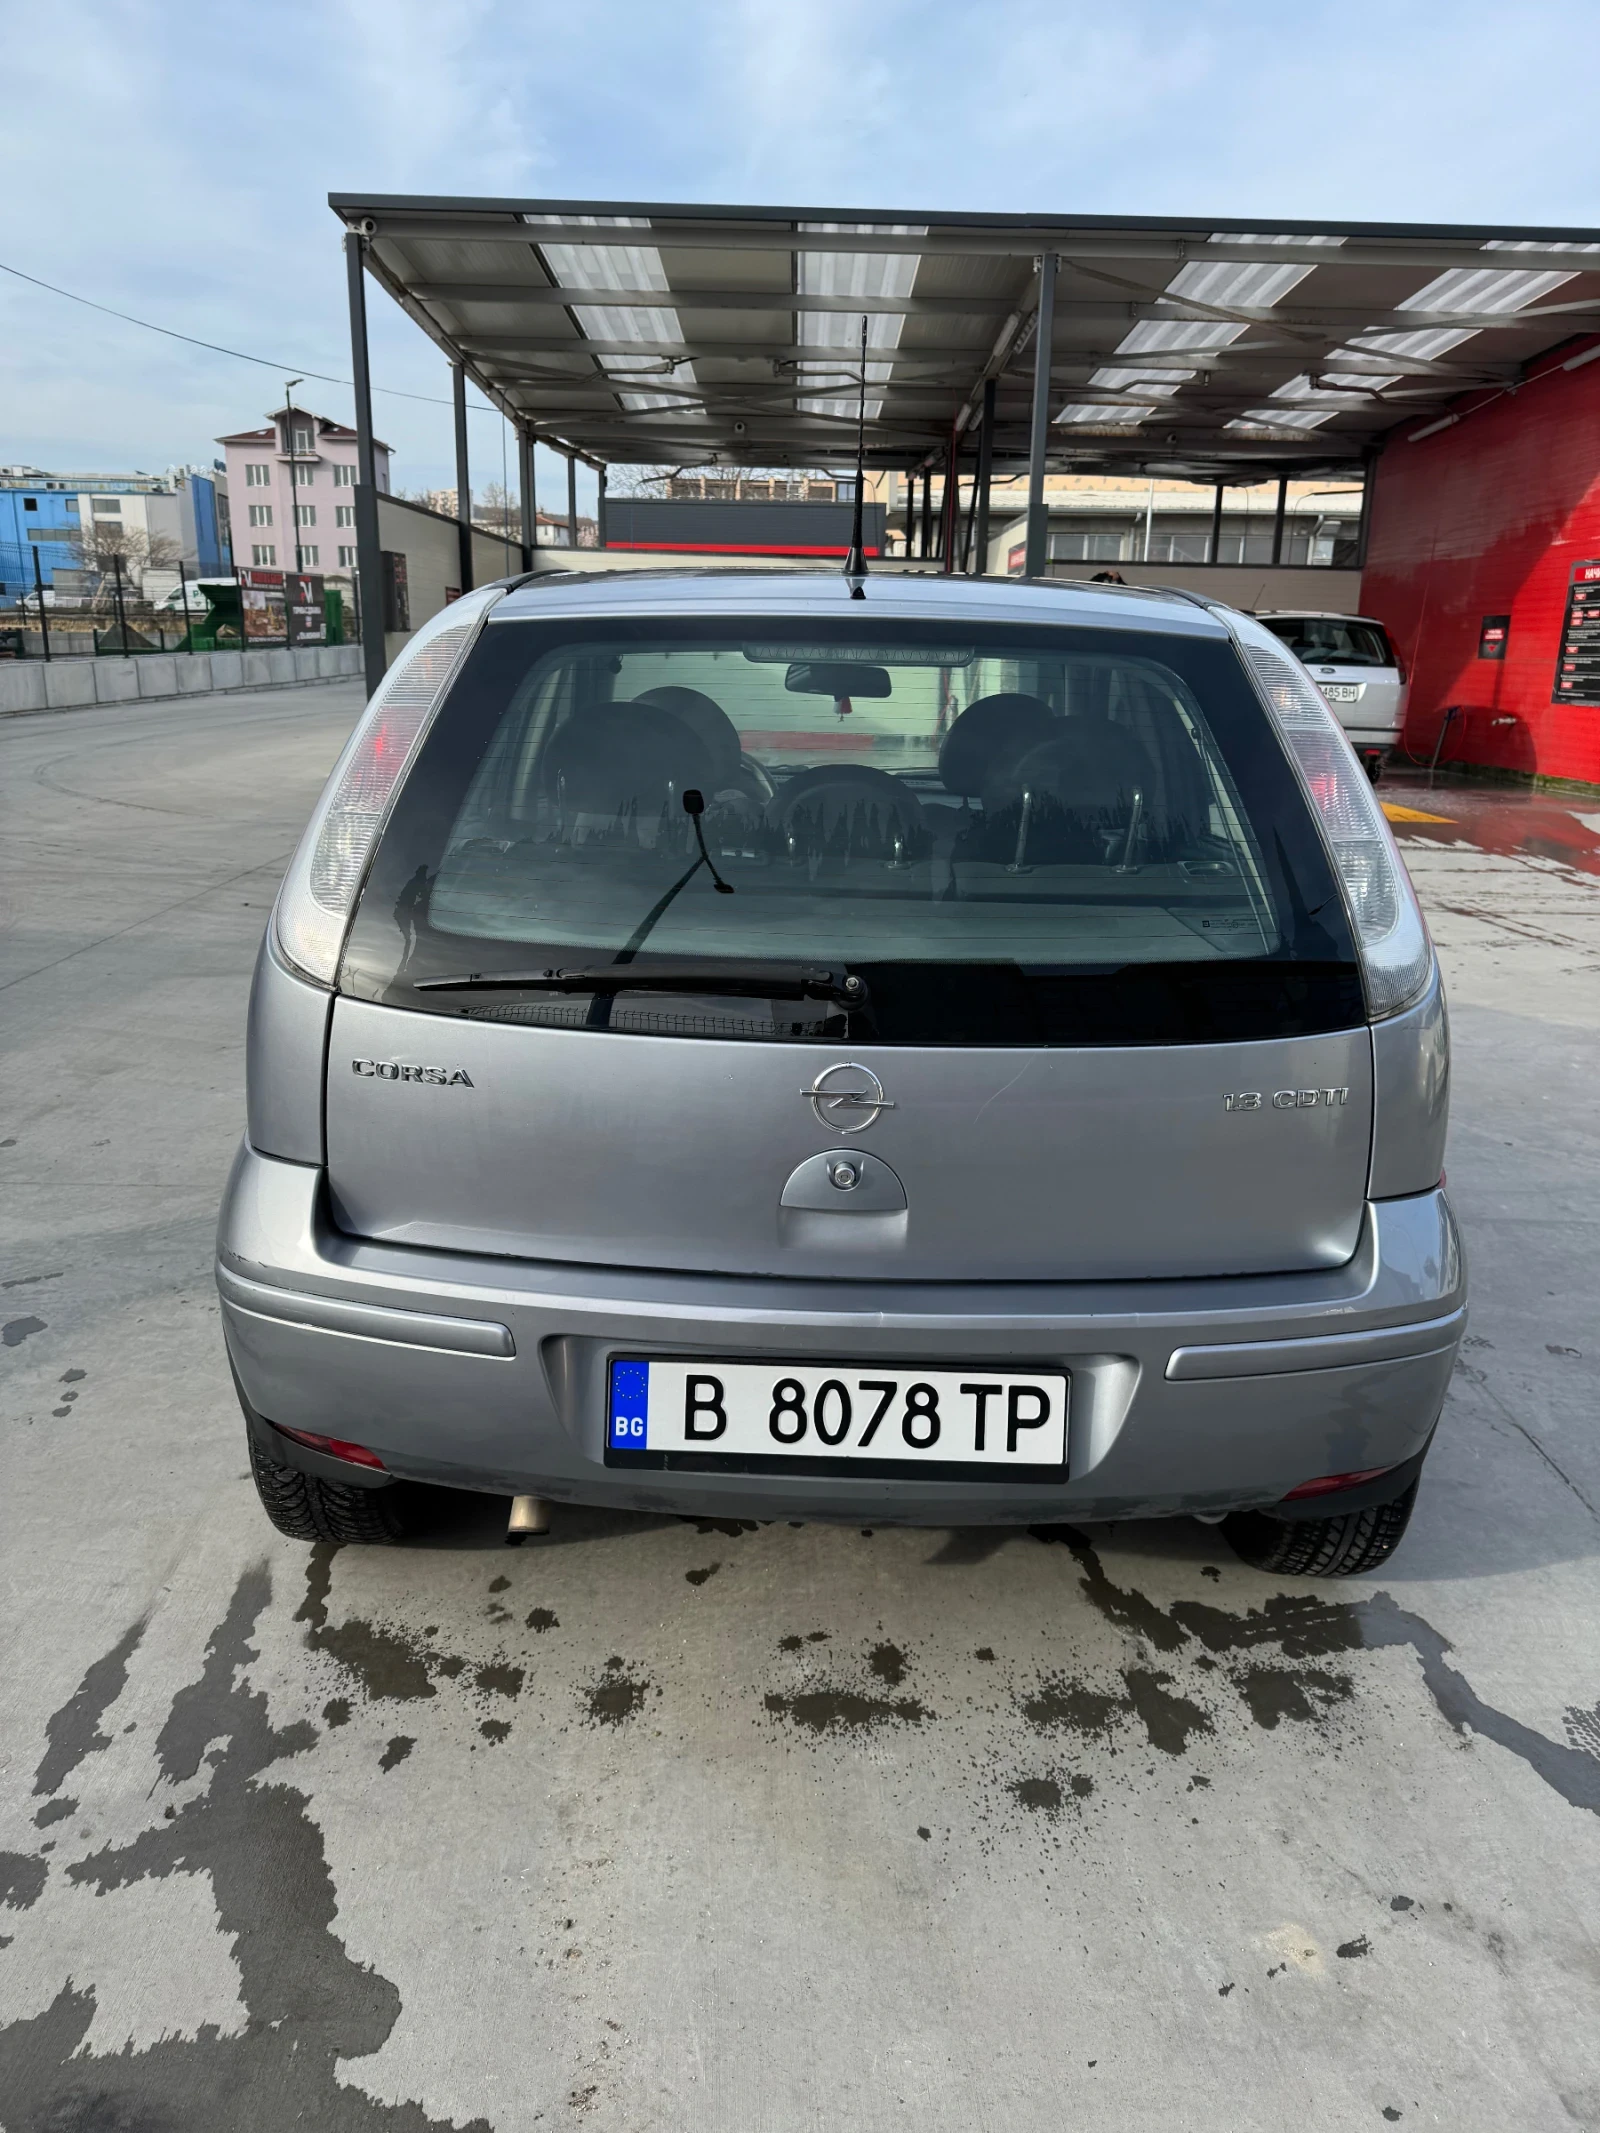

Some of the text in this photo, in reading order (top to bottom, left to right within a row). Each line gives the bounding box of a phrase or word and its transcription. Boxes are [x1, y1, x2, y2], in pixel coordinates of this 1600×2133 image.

[352, 1058, 475, 1088] CORSA
[1272, 1087, 1349, 1109] CDTI
[615, 1416, 644, 1437] BG
[684, 1374, 1051, 1453] B 8078 TP
